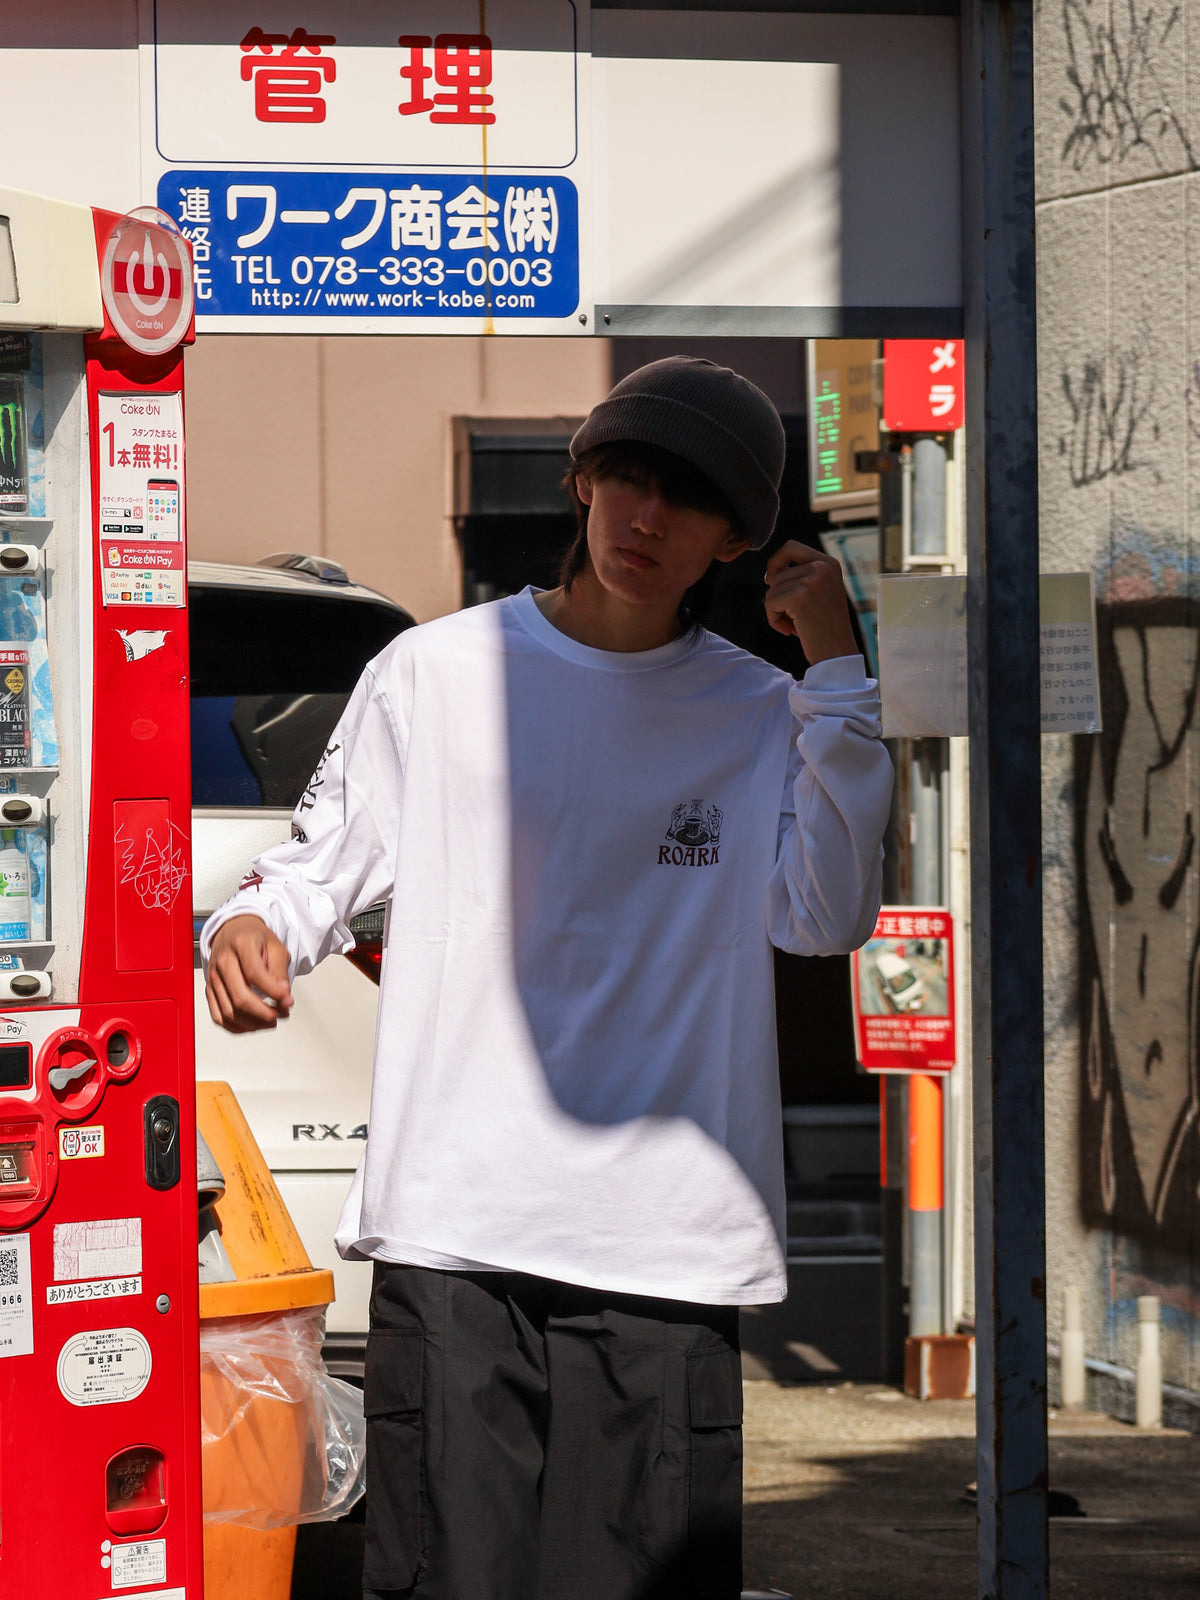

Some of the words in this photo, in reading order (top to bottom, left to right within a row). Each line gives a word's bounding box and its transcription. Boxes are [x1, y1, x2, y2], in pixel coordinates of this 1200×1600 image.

[240, 27, 496, 125] 管理
[230, 255, 281, 285] TEL
[291, 255, 553, 287] 078-333-0003
[135, 319, 152, 329] Coke
[121, 404, 144, 414] Coke
[122, 554, 143, 564] Coke
[157, 556, 173, 568] Pay
[7, 1025, 22, 1035] Pay
[84, 1143, 98, 1153] OK
[49, 1279, 140, 1302] ありがとうございます
